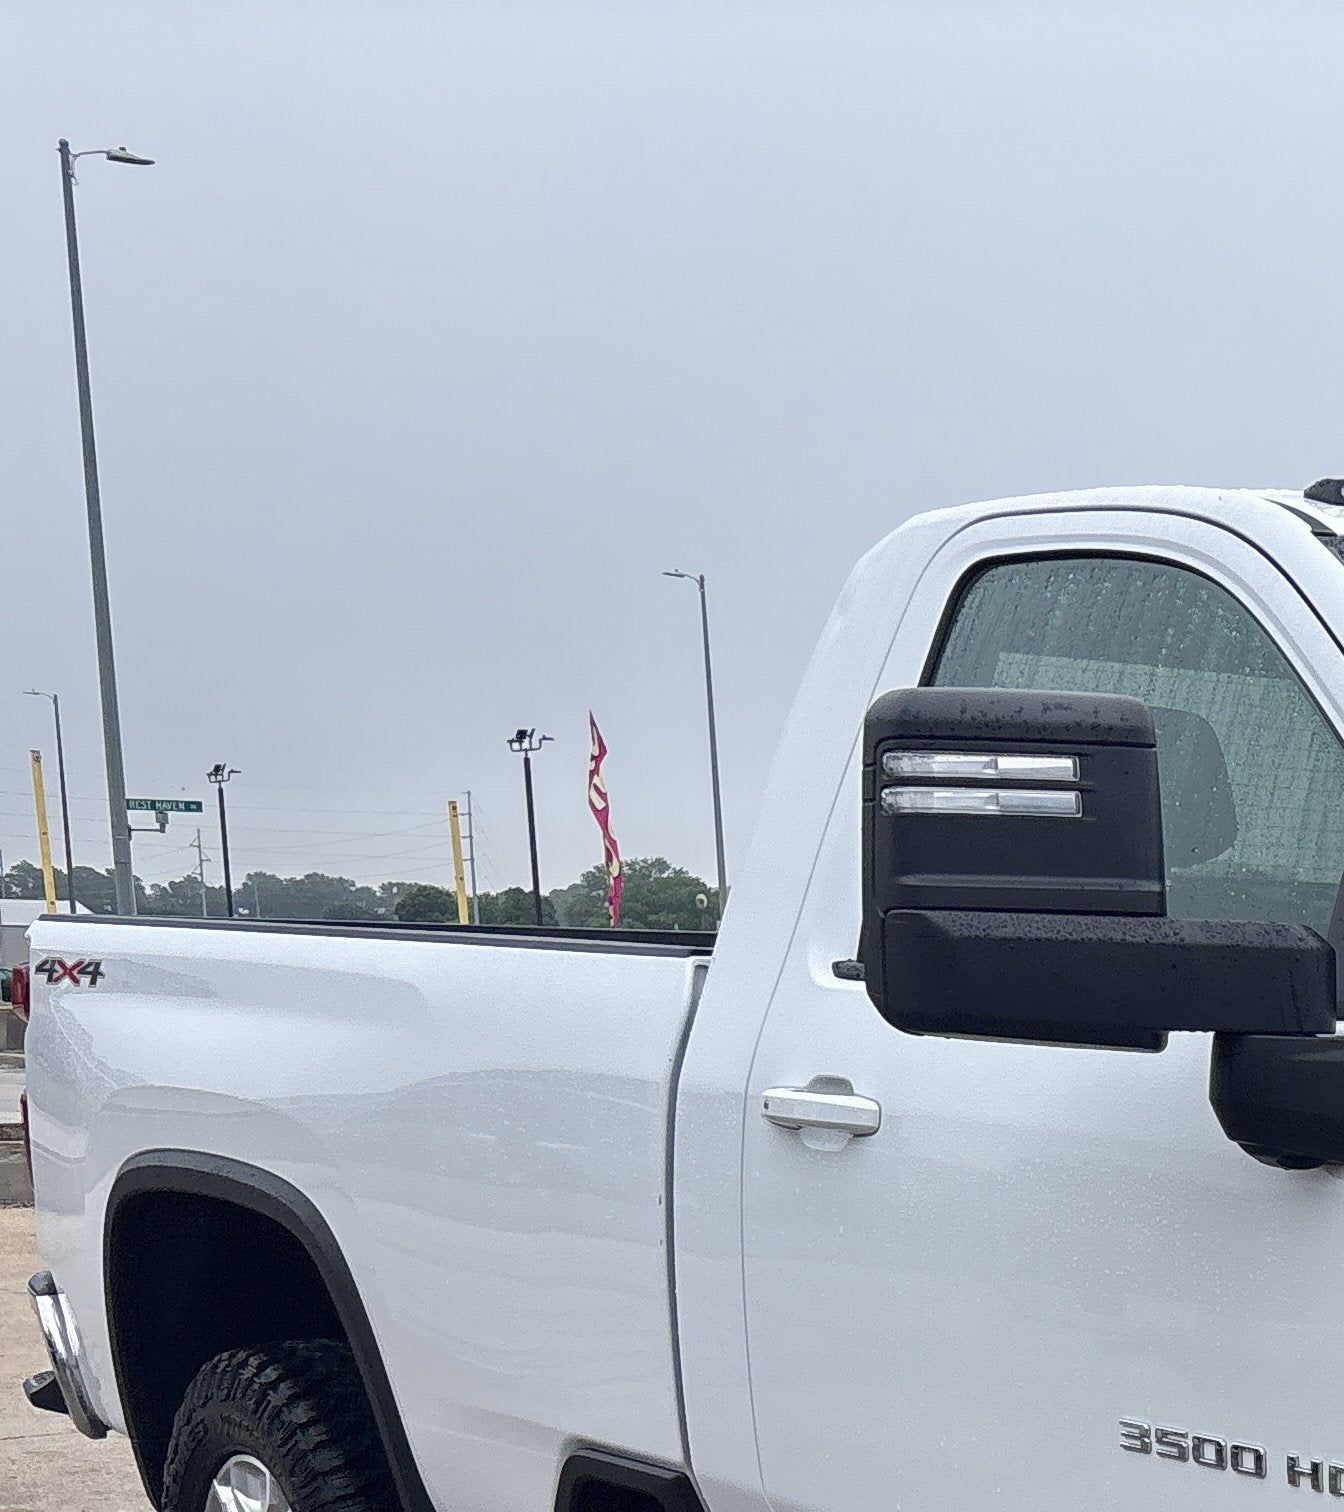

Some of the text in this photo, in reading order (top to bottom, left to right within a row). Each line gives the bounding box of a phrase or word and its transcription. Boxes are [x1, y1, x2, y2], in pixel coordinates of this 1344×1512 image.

[128, 800, 152, 810] REST
[155, 801, 185, 811] HAVEN
[1118, 1416, 1268, 1479] 3500
